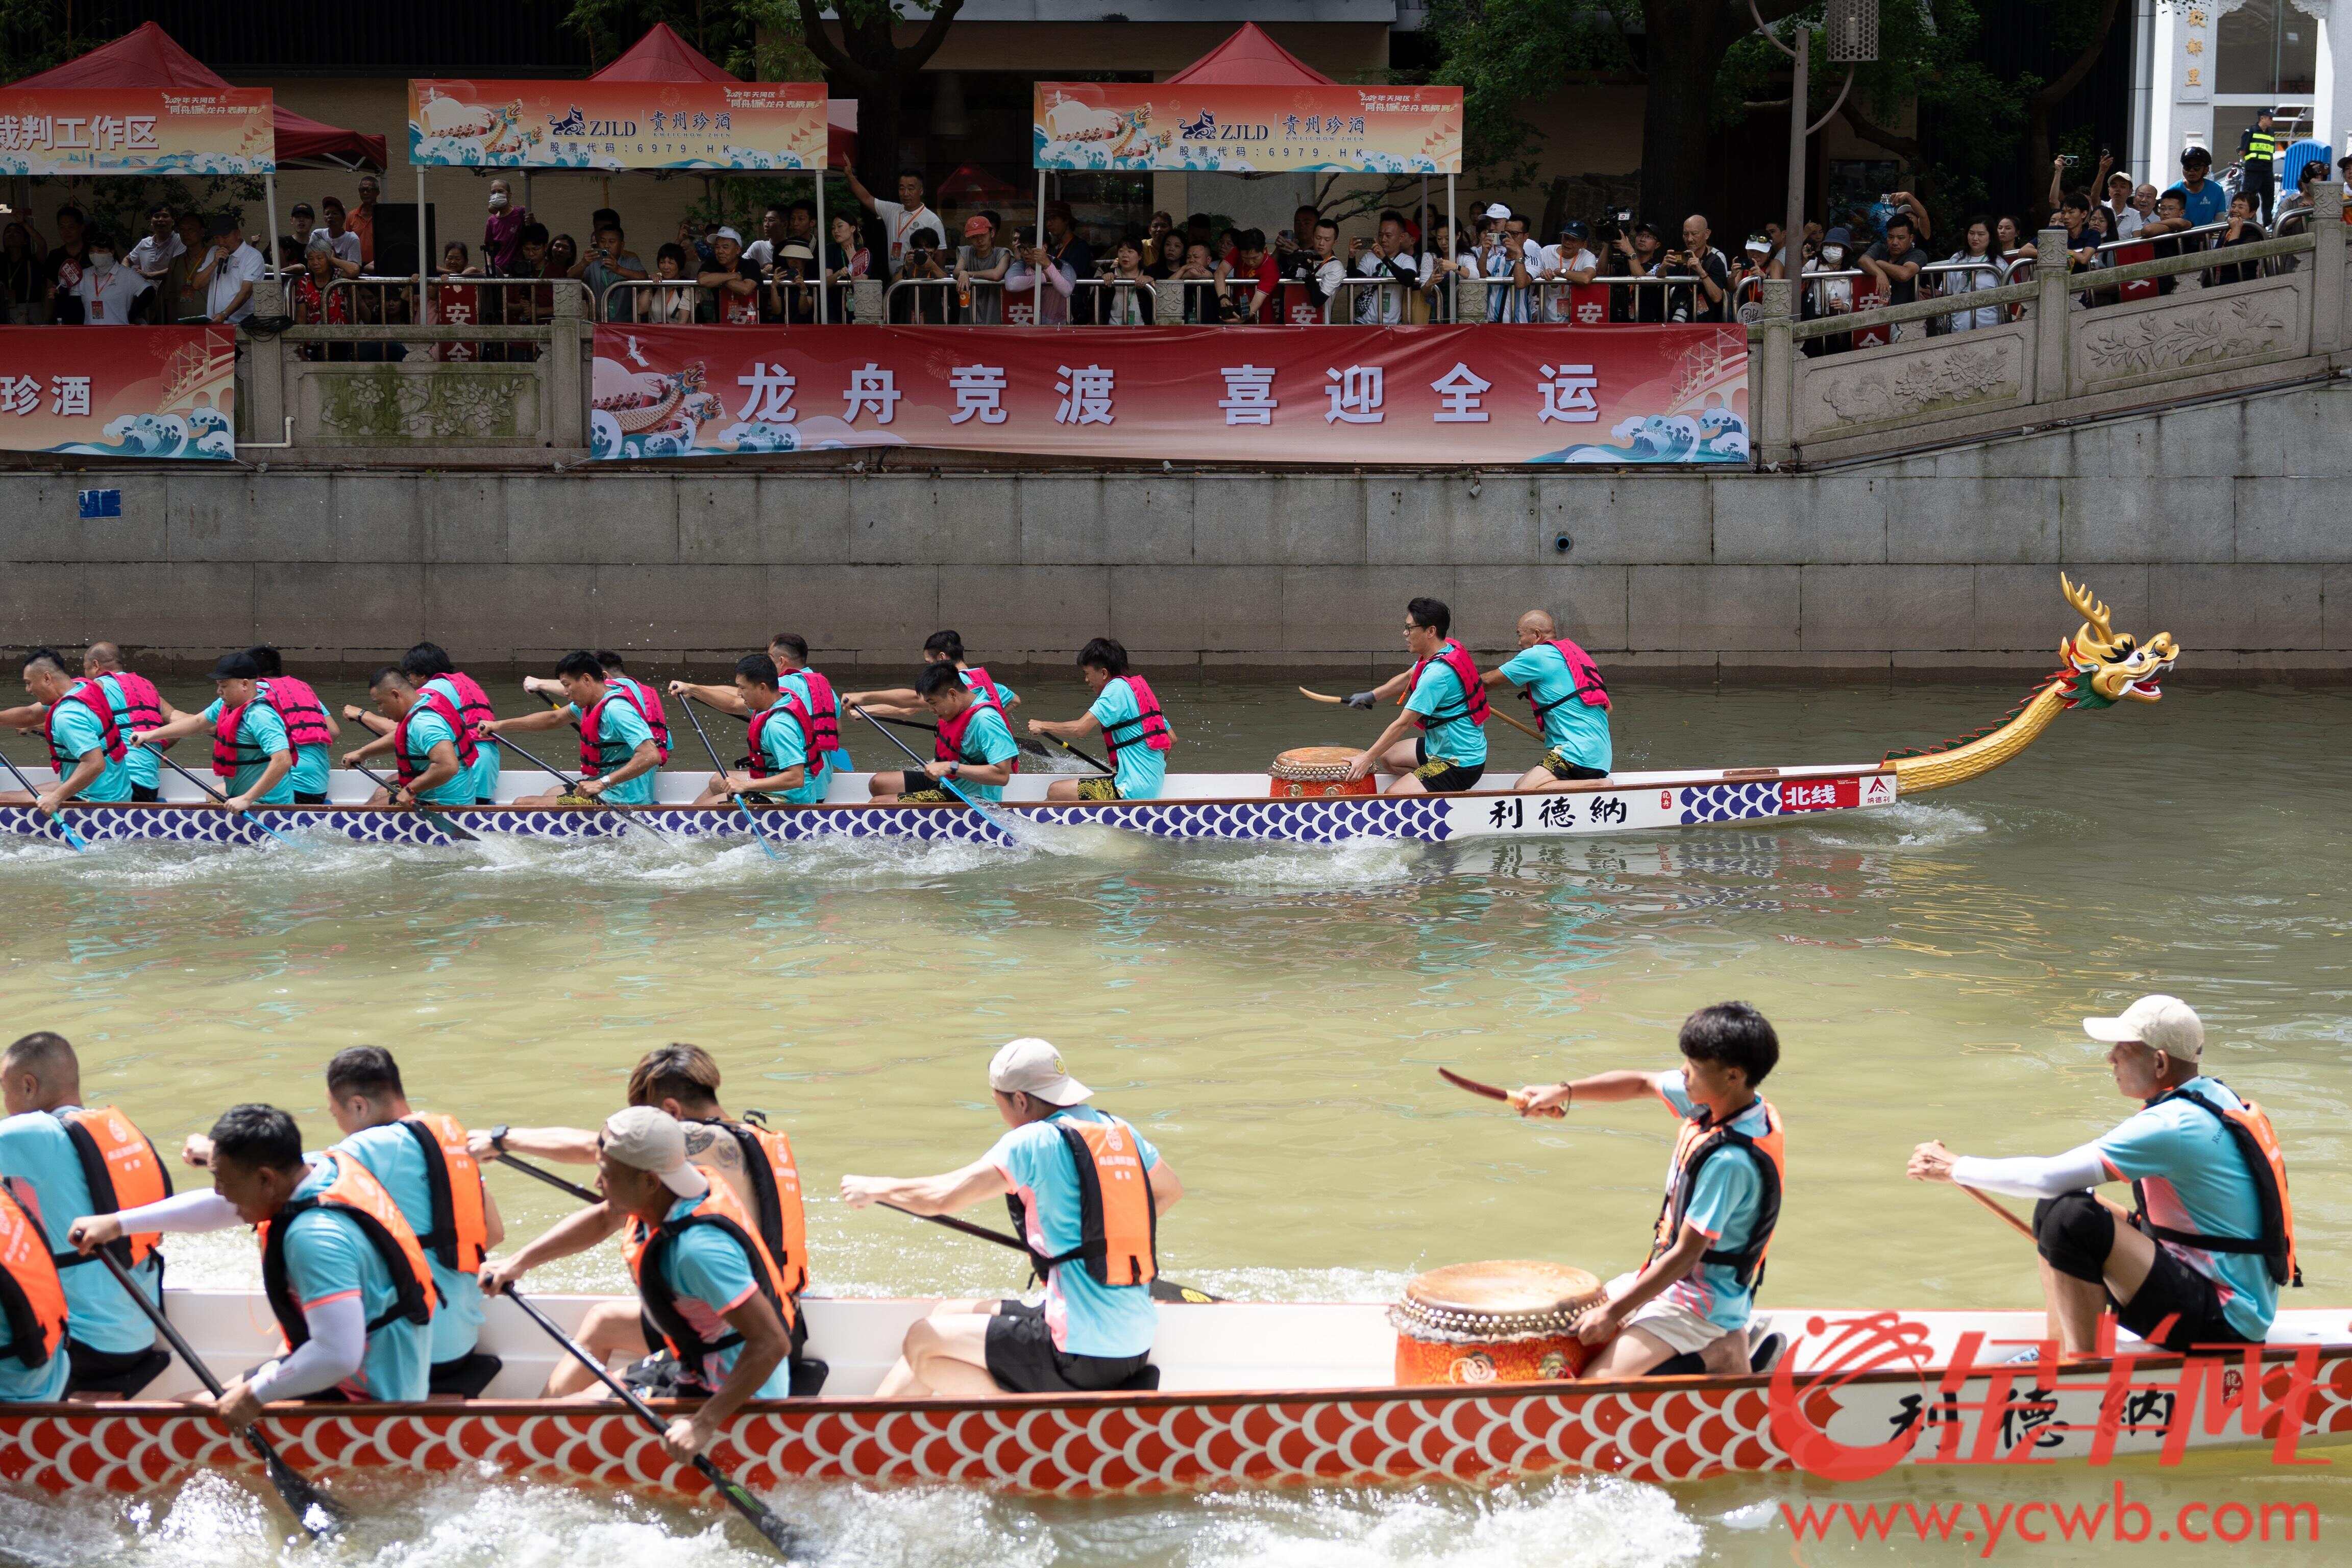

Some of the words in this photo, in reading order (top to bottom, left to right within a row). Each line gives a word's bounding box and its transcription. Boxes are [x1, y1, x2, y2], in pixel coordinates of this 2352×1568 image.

[590, 120, 637, 137] ZJLD
[649, 109, 731, 132] 贵州珍酒
[1282, 114, 1365, 135] 贵州珍酒
[0, 115, 158, 151] 裁判工作区
[1220, 124, 1268, 140] ZJLD
[0, 374, 91, 416] 珍酒
[737, 362, 1116, 425] 龙舟竞渡
[1218, 362, 1600, 425] 喜迎全运
[1785, 785, 1836, 806] 北线
[1867, 796, 1890, 804] 纳德利
